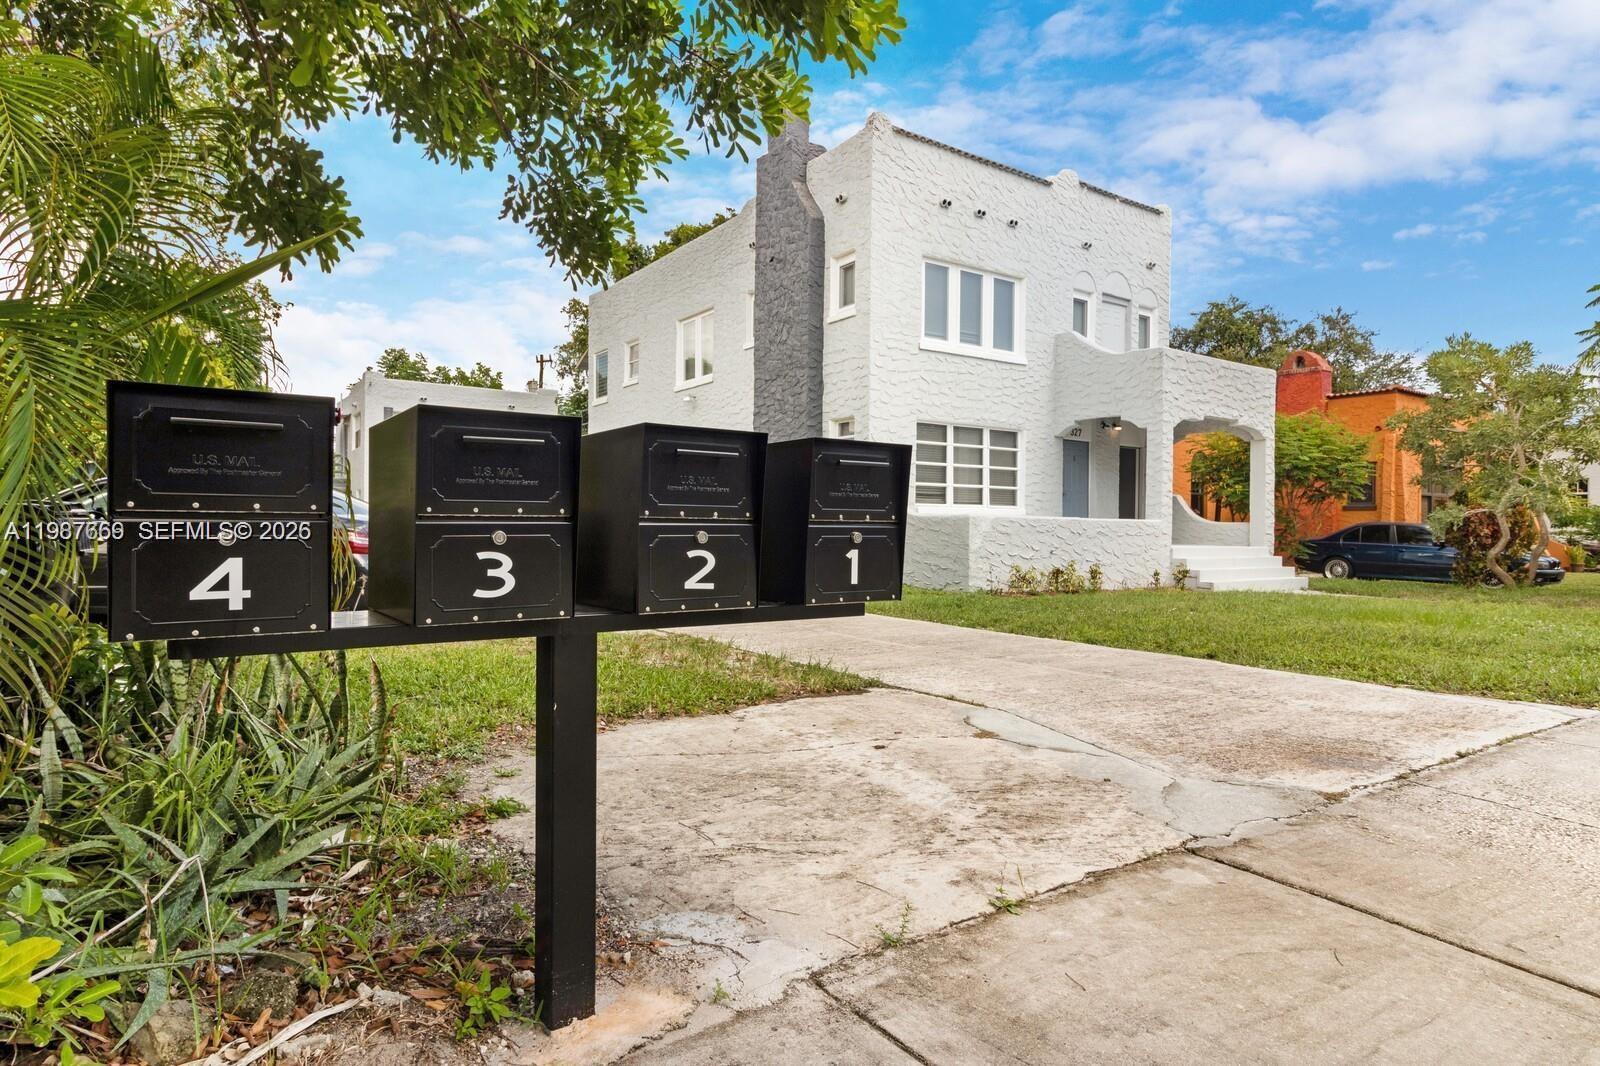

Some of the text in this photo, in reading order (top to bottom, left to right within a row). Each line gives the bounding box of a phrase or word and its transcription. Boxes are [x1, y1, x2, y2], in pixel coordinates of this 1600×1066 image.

[192, 453, 221, 466] U.S.
[473, 465, 495, 477] U.S.
[189, 556, 252, 611] 4
[472, 551, 515, 599] 3
[683, 549, 716, 590] 2
[846, 549, 859, 585] 1
